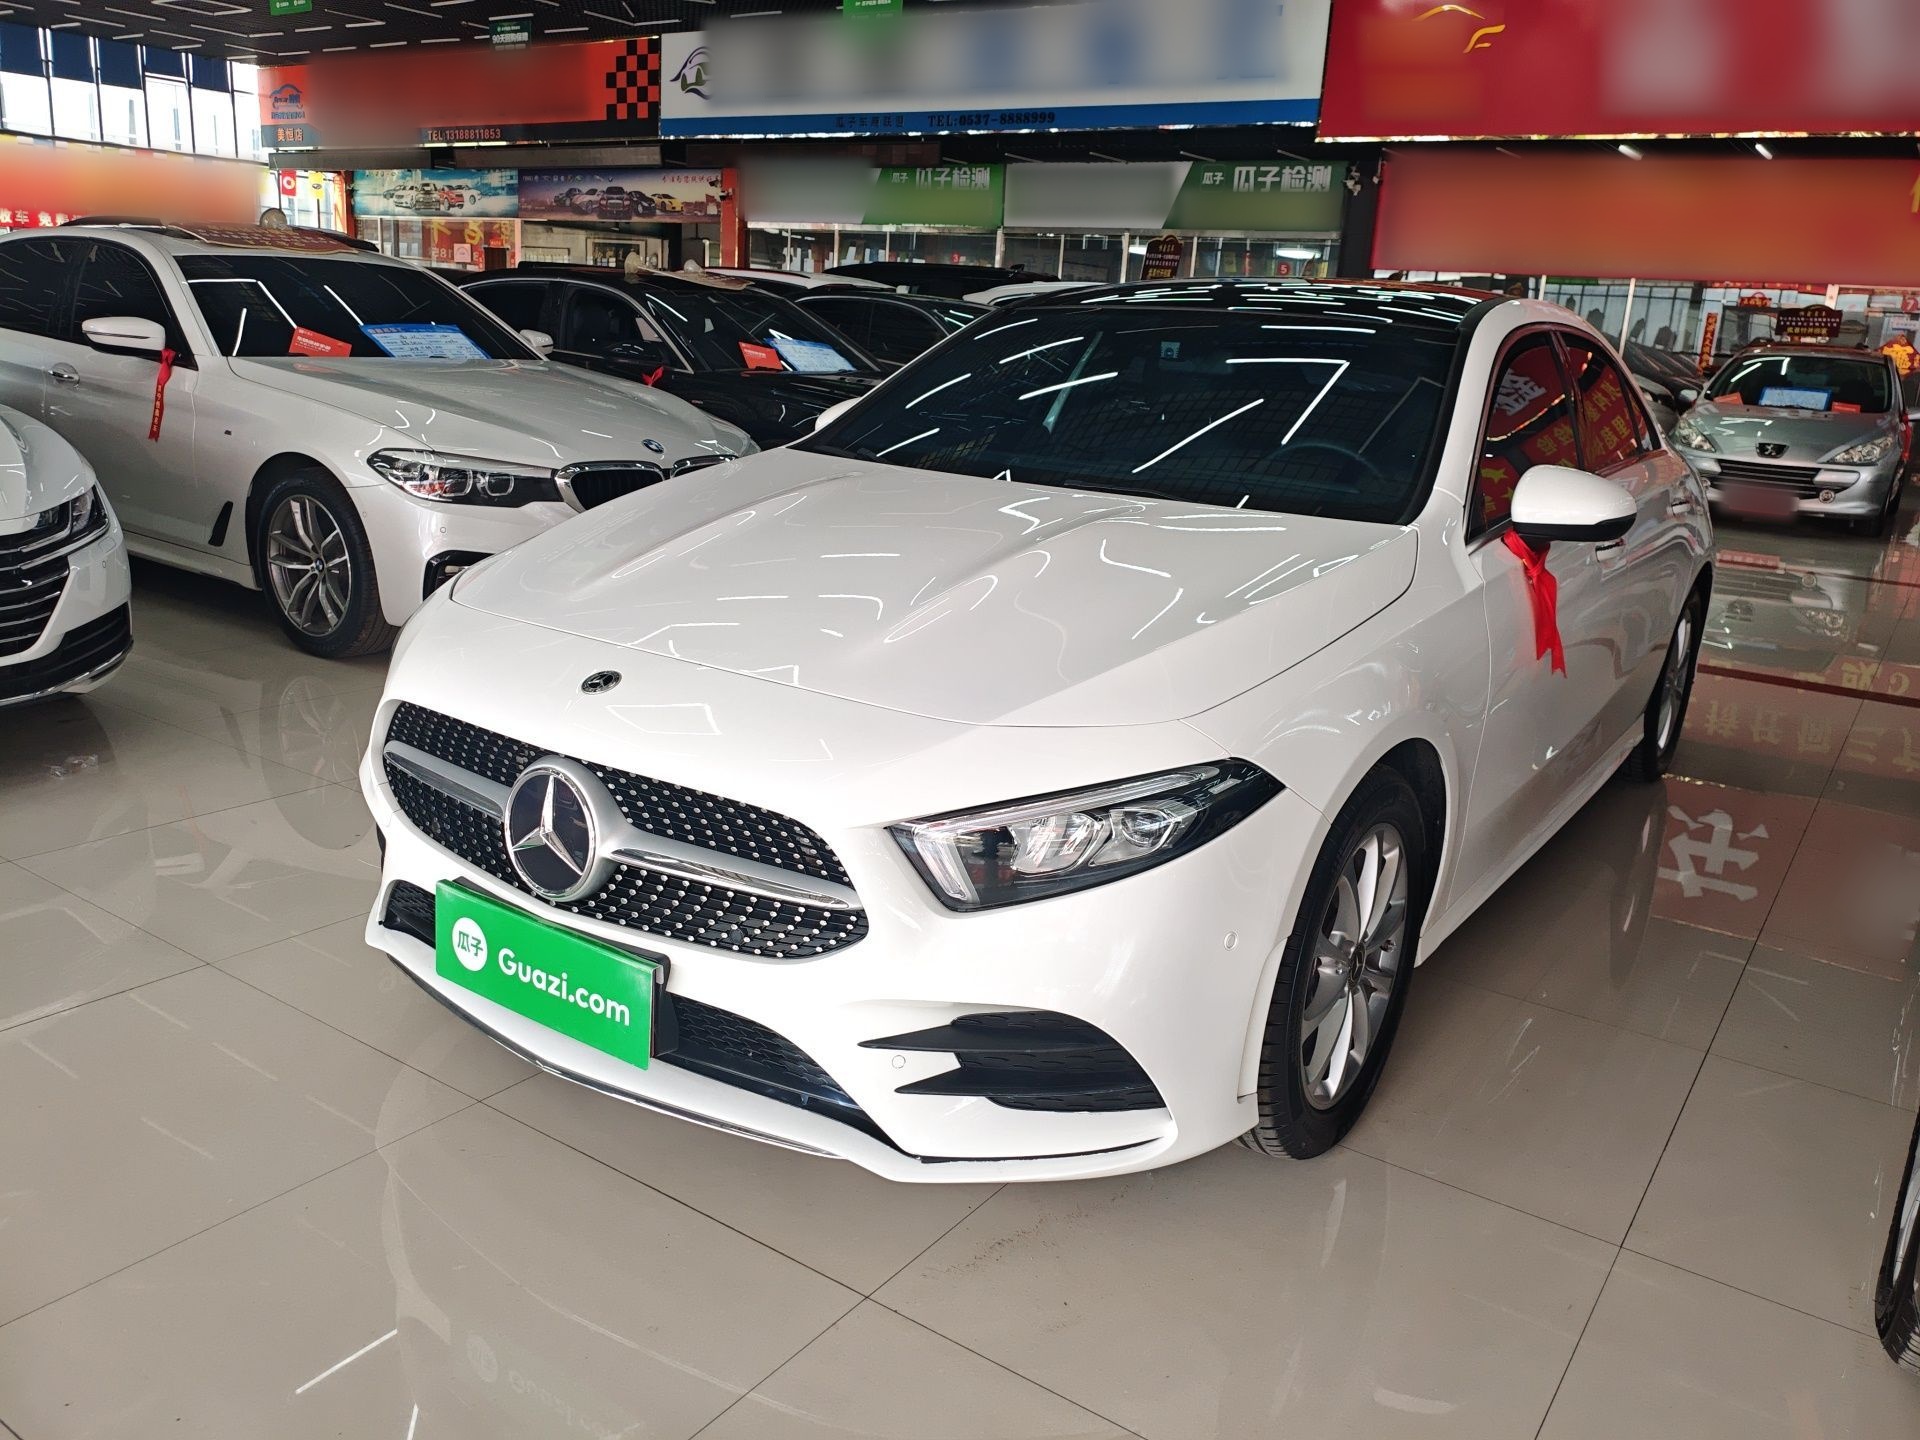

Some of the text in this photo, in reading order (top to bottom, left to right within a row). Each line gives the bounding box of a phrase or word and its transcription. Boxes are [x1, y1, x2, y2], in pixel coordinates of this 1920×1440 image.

[927, 111, 1056, 128] TEL:0537-8888999
[277, 127, 304, 142] 美恒店
[915, 167, 990, 190] 瓜子检测
[1202, 171, 1225, 185] 瓜子
[1232, 165, 1333, 193] 瓜子检测
[457, 929, 484, 957] 瓜子
[498, 947, 630, 1027] Guazi.com
